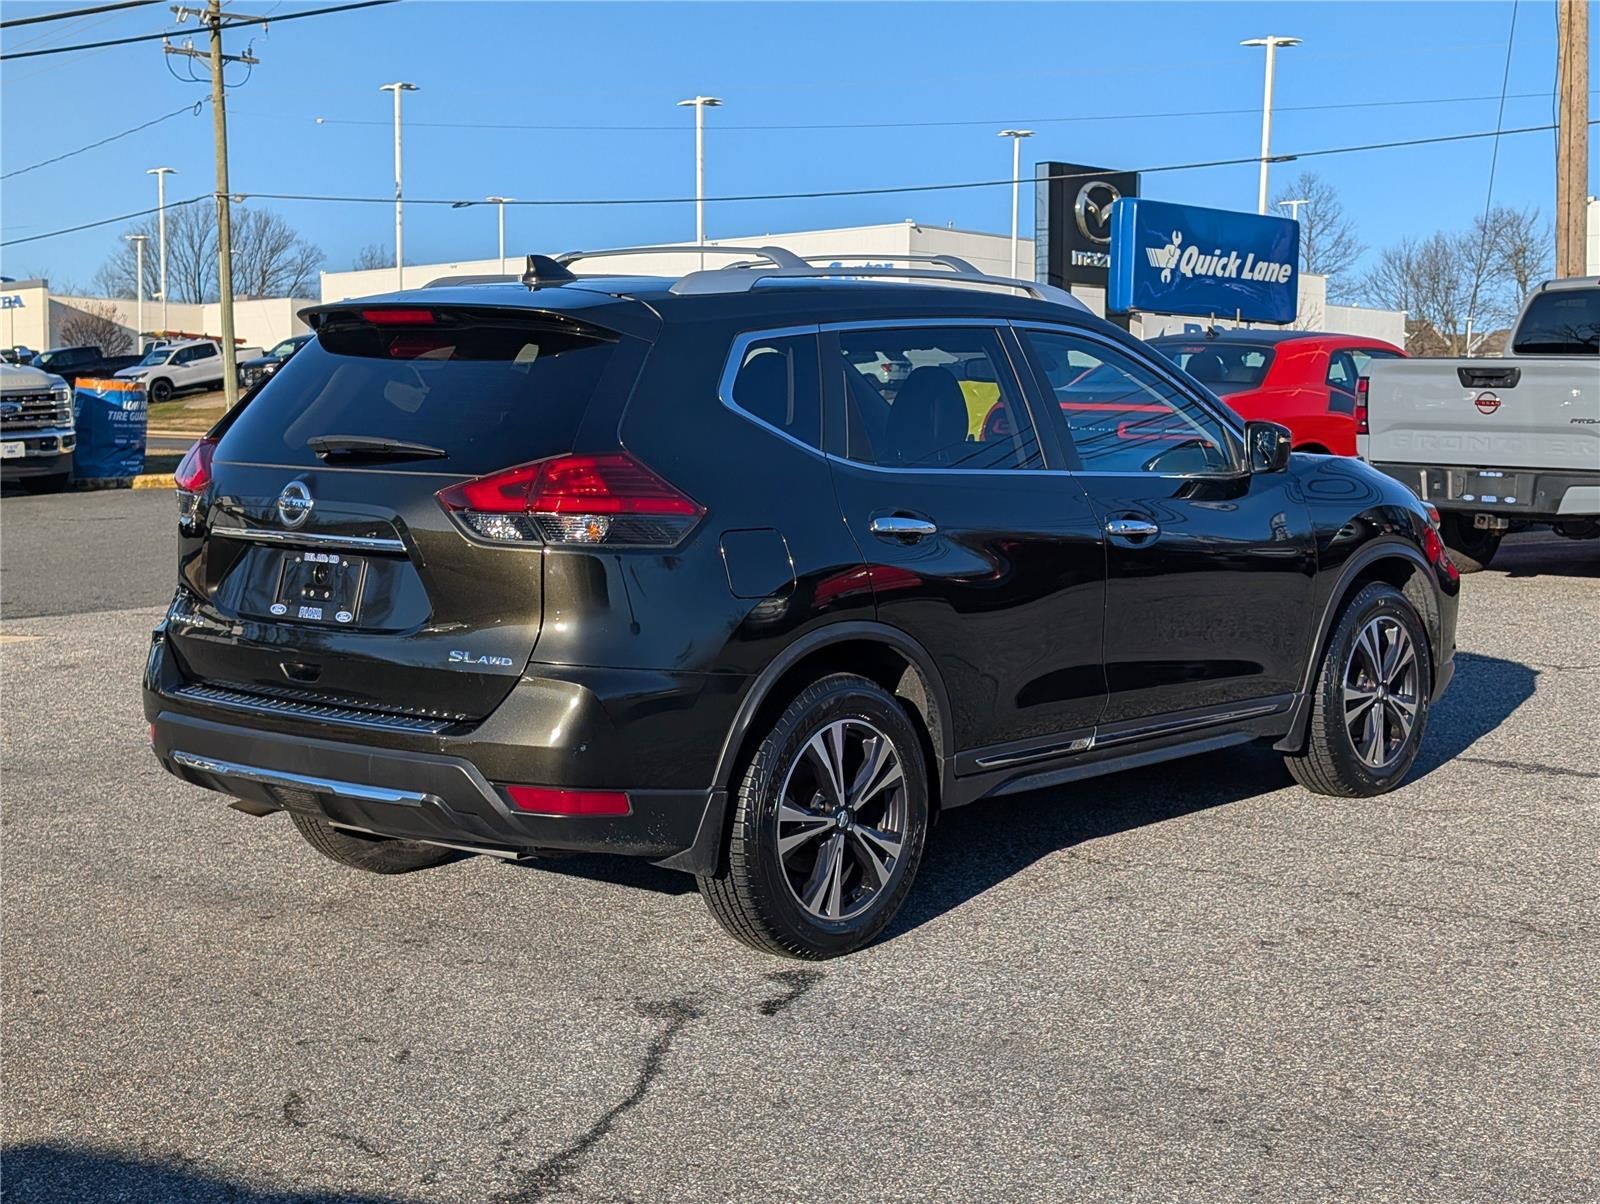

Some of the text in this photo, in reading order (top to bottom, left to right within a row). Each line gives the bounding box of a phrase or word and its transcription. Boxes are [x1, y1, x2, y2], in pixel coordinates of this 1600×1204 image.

[1180, 245, 1292, 284] Quick Lane
[123, 400, 139, 411] LOW
[108, 410, 128, 421] TIRE
[448, 650, 513, 666] SL AWD
